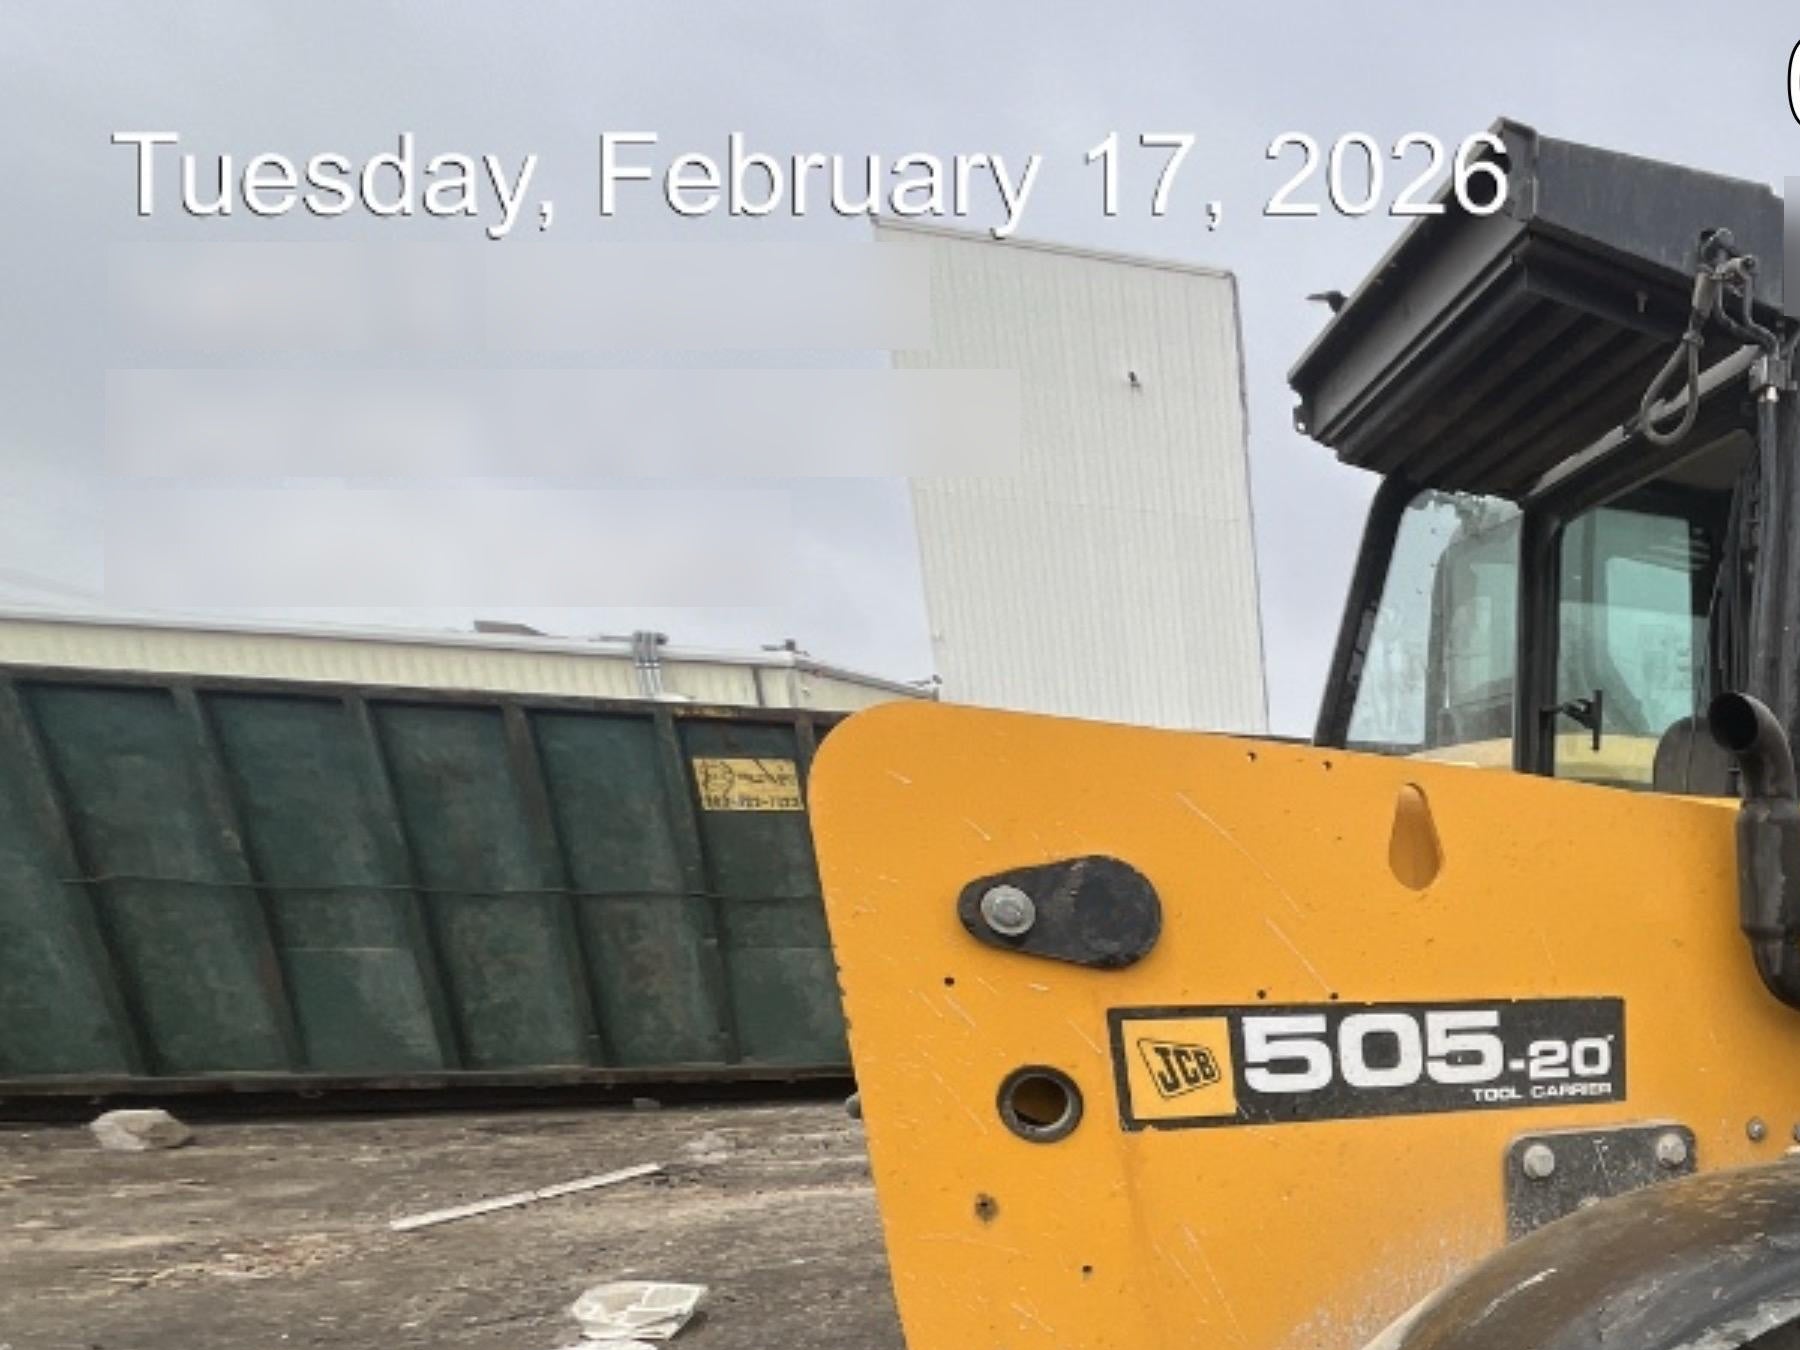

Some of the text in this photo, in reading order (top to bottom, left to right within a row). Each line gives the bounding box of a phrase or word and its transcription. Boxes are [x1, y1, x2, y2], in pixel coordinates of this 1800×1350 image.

[1153, 1046, 1217, 1093] JCB
[1472, 1082, 1612, 1102] TOOL CARRIER
